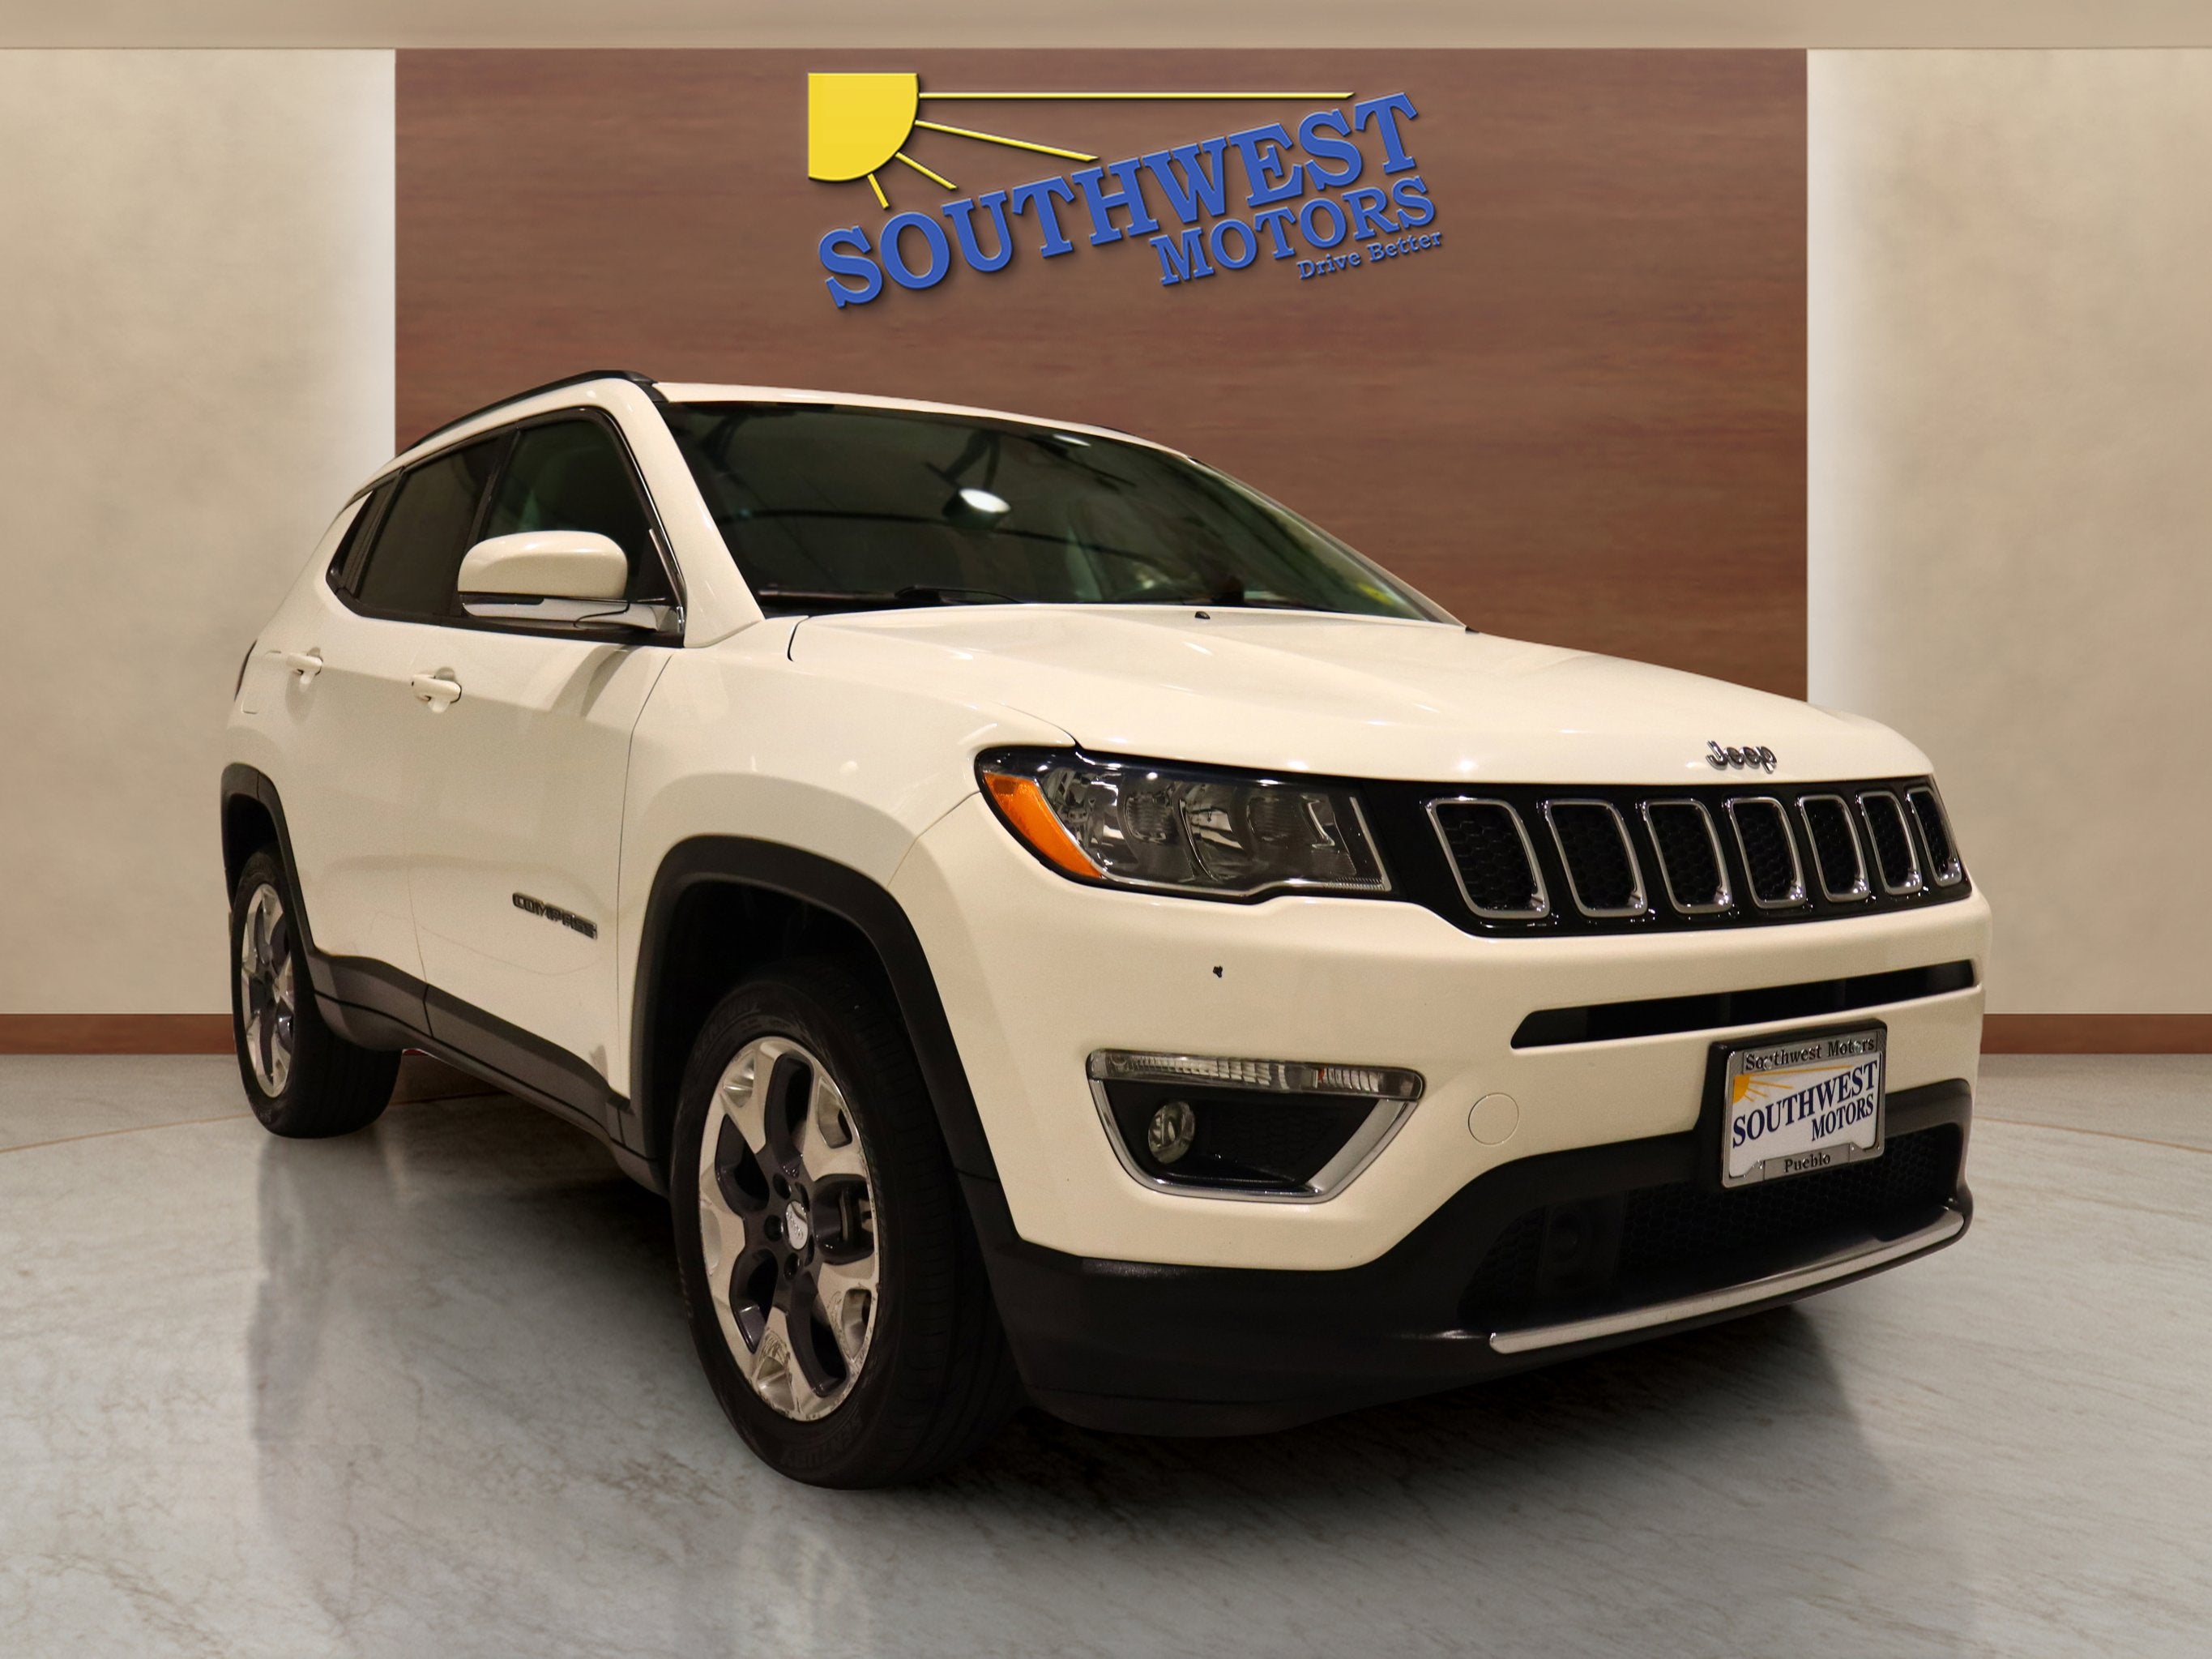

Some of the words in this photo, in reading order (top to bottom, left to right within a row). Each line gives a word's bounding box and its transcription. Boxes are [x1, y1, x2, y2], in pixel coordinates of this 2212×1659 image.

[818, 92, 1418, 307] SOUTHWEST
[1149, 176, 1435, 285] MOTORS
[1297, 252, 1361, 279] Drive
[1367, 232, 1442, 262] Better
[1706, 741, 1777, 774] Jeep
[1732, 1060, 1877, 1148] SOUTHWEST
[1811, 1094, 1873, 1141] MOTORS
[1784, 1152, 1831, 1173] Pueblo
